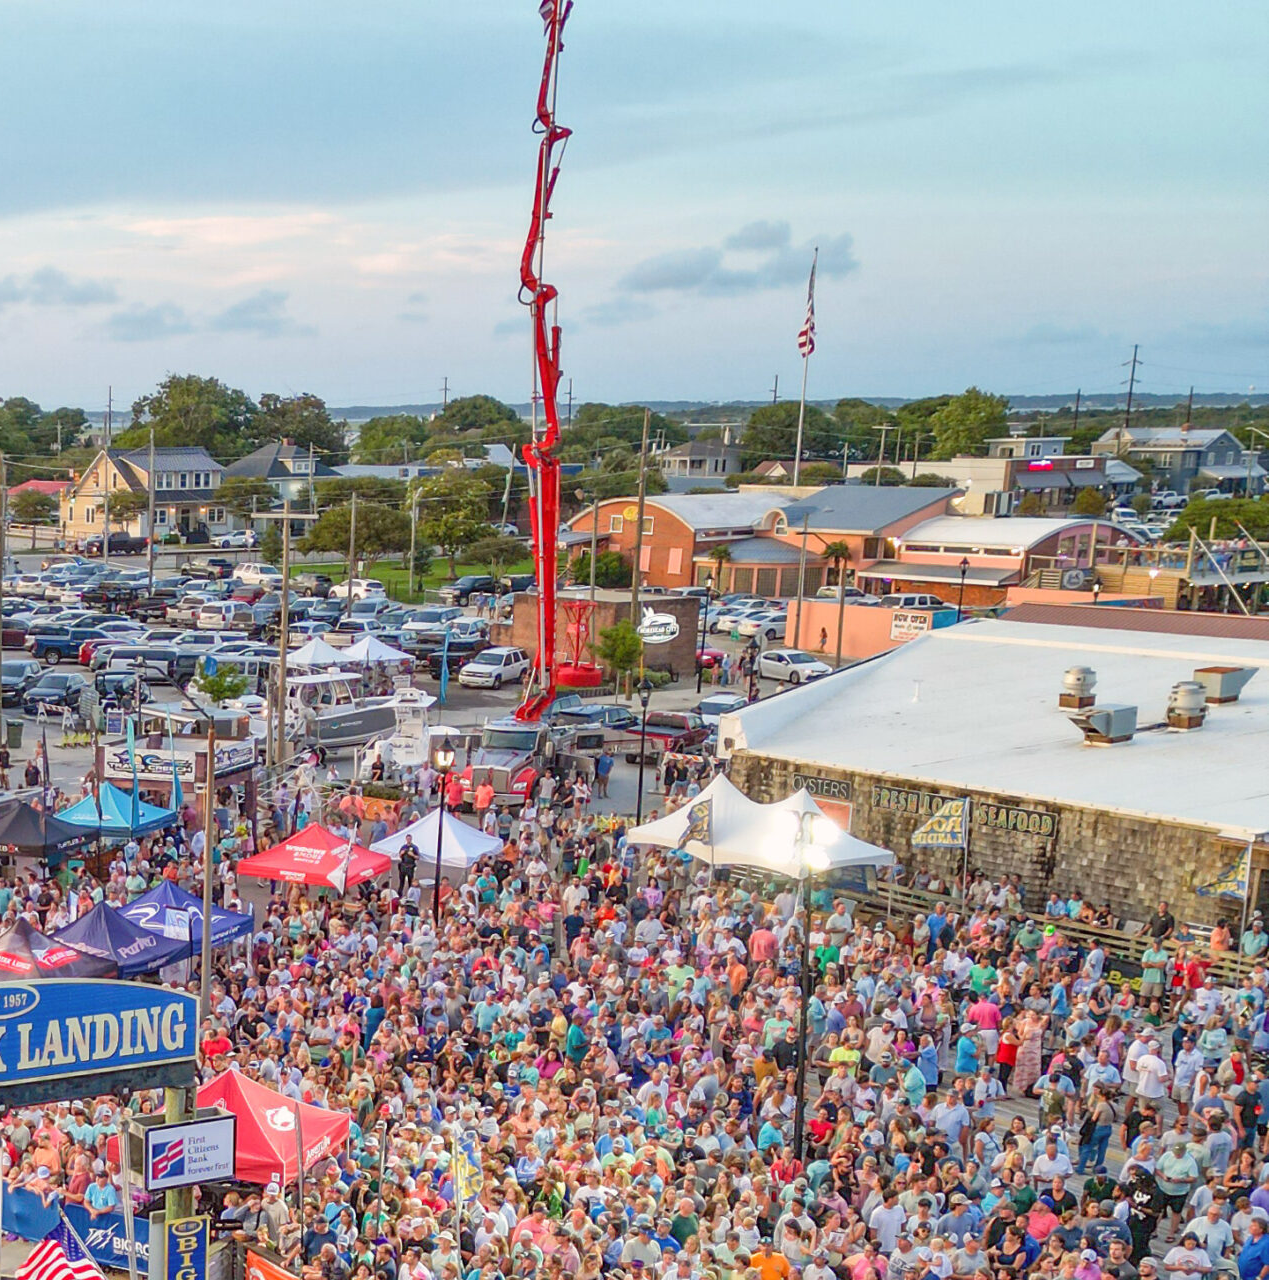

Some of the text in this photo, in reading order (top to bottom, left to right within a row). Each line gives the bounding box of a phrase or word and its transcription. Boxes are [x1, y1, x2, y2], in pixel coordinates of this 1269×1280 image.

[793, 774, 848, 798] OYSTERS
[872, 786, 918, 813] FRESH
[979, 804, 1053, 835] SEAFOOD
[3, 992, 28, 1008] 1957
[17, 1002, 187, 1071] LANDING
[187, 1136, 206, 1146] First
[187, 1144, 219, 1155] Citizens
[187, 1153, 208, 1164] Bank
[187, 1165, 214, 1175] forever
[112, 1236, 150, 1256] BIG RO
